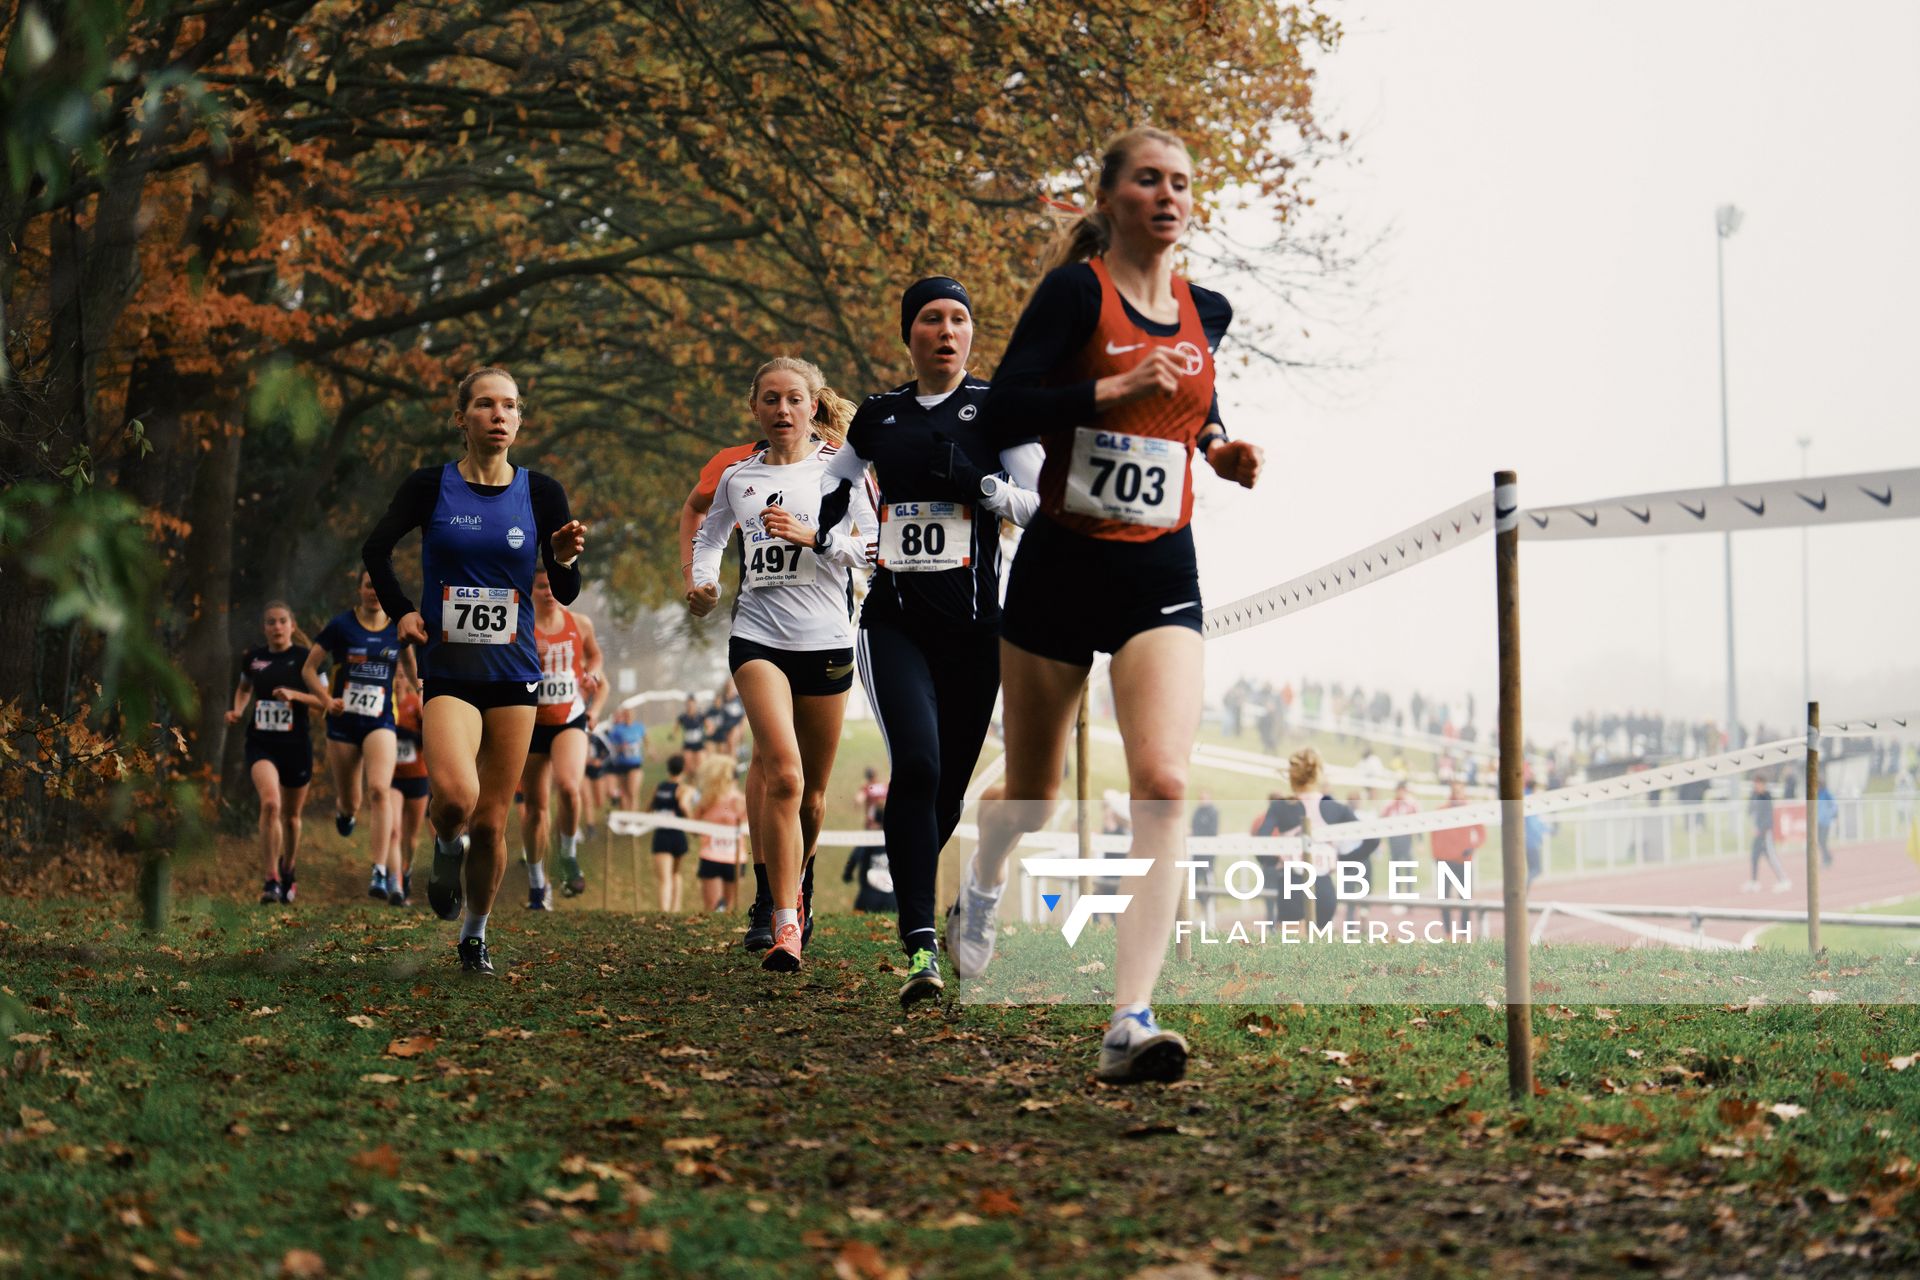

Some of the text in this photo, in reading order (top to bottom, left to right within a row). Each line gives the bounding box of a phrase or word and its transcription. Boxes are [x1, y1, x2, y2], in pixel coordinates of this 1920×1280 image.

[1089, 456, 1166, 507] 703
[902, 523, 945, 556] 80
[751, 545, 802, 574] 497
[454, 603, 507, 632] 763
[350, 692, 378, 709] 747
[539, 682, 574, 697] 1031
[257, 709, 291, 724] 1112
